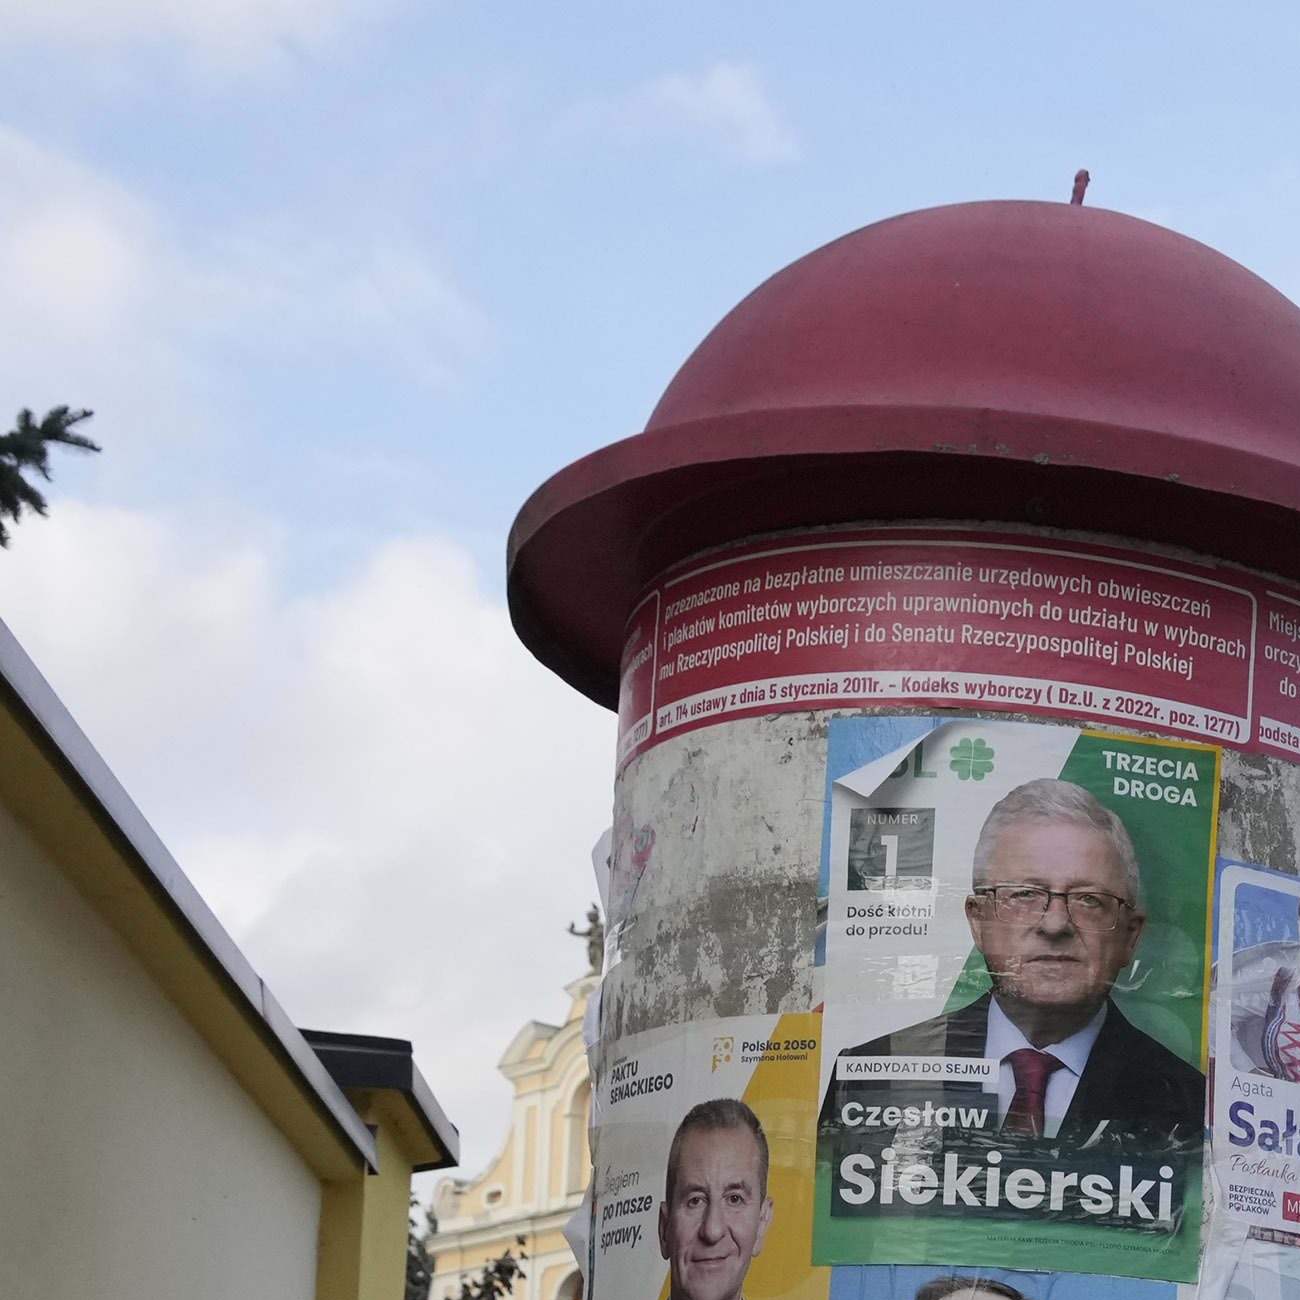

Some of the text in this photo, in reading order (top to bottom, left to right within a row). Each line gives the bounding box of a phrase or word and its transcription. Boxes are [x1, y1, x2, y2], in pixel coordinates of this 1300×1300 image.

[665, 560, 1211, 624] przeznaczone na bezpłatne umieszczanie urzędowych obwieszczeń
[662, 631, 668, 650] i
[668, 614, 716, 652] plakatów
[718, 600, 791, 630] komitetów
[796, 592, 898, 620] wyborczych
[902, 593, 1034, 620] uprawnionych
[1040, 600, 1063, 621] do
[1068, 605, 1138, 633] udziału
[1144, 619, 1159, 636] w
[1164, 622, 1246, 659] wyborach
[677, 630, 782, 674] Rzeczypospolitej
[786, 625, 849, 649] Polskiej
[854, 624, 860, 643] i
[865, 624, 886, 643] do
[891, 623, 955, 644] Senatu
[961, 624, 1119, 665] Rzeczypospolitej
[1125, 643, 1194, 680] Polskiej
[1279, 677, 1297, 698] do
[659, 676, 1241, 739] art. 114 ustawy z dnia 5 stycznia 2011r. Kodeks wyborczy Dz.U. z 2022r. poz. 1277)
[1102, 751, 1200, 782] TRZECIA
[1113, 776, 1198, 808] DROGA
[867, 813, 919, 826] NUMER
[880, 835, 899, 877] 1
[847, 905, 884, 919] Dość
[846, 923, 928, 940] do przodu!
[741, 1052, 808, 1064] Szymona Hołowni
[742, 1039, 817, 1053] Polska 2050
[611, 1060, 638, 1086] PAKTU
[845, 1063, 991, 1076] KANDYDAT DO SEJMU
[610, 1073, 673, 1105] SENACKIEGO
[1231, 1075, 1273, 1099] Agata
[840, 1100, 989, 1129] Czesław
[1230, 1153, 1298, 1185] Posłanka
[838, 1147, 1175, 1222] Siekierski
[1229, 1184, 1275, 1199] BEZPIECZNA
[602, 1195, 653, 1229] po nasze
[1229, 1193, 1277, 1208] PRZYSZŁOŚĆ
[601, 1224, 642, 1256] sprawy.
